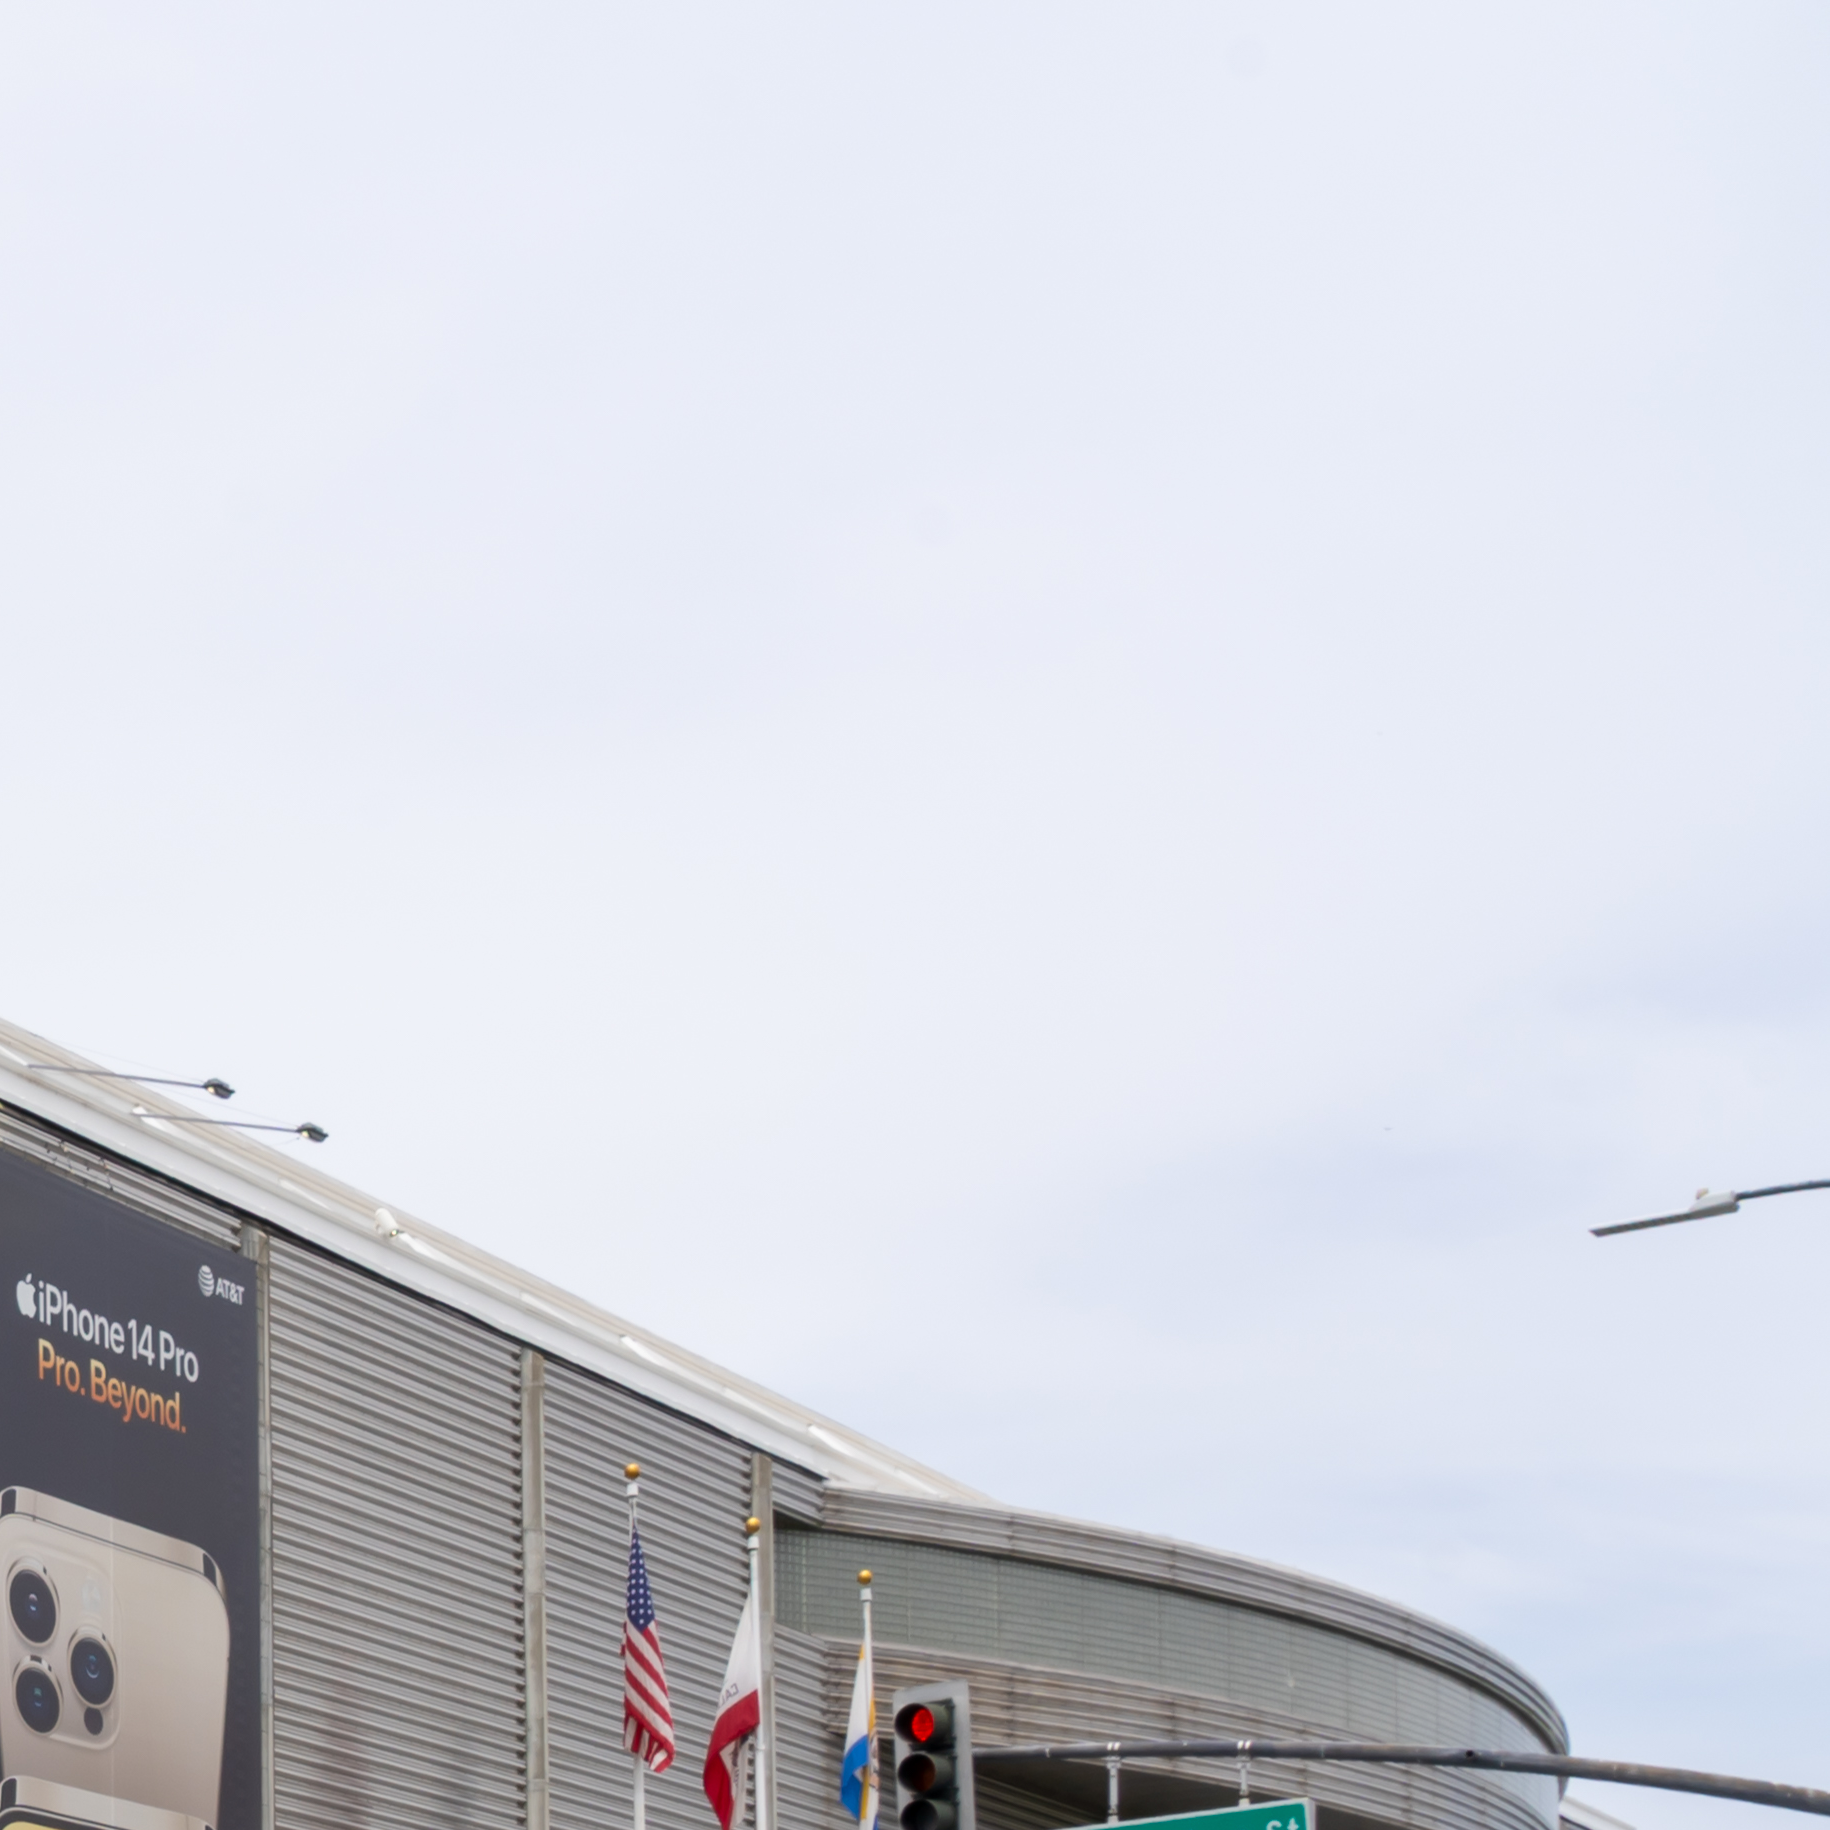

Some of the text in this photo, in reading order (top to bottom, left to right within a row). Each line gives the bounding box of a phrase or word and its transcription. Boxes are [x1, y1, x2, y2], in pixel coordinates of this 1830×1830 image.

[38, 1281, 199, 1382] iPhone 14 Pro
[215, 1278, 244, 1305] AT&T
[38, 1338, 186, 1433] Pro. Beyond.
